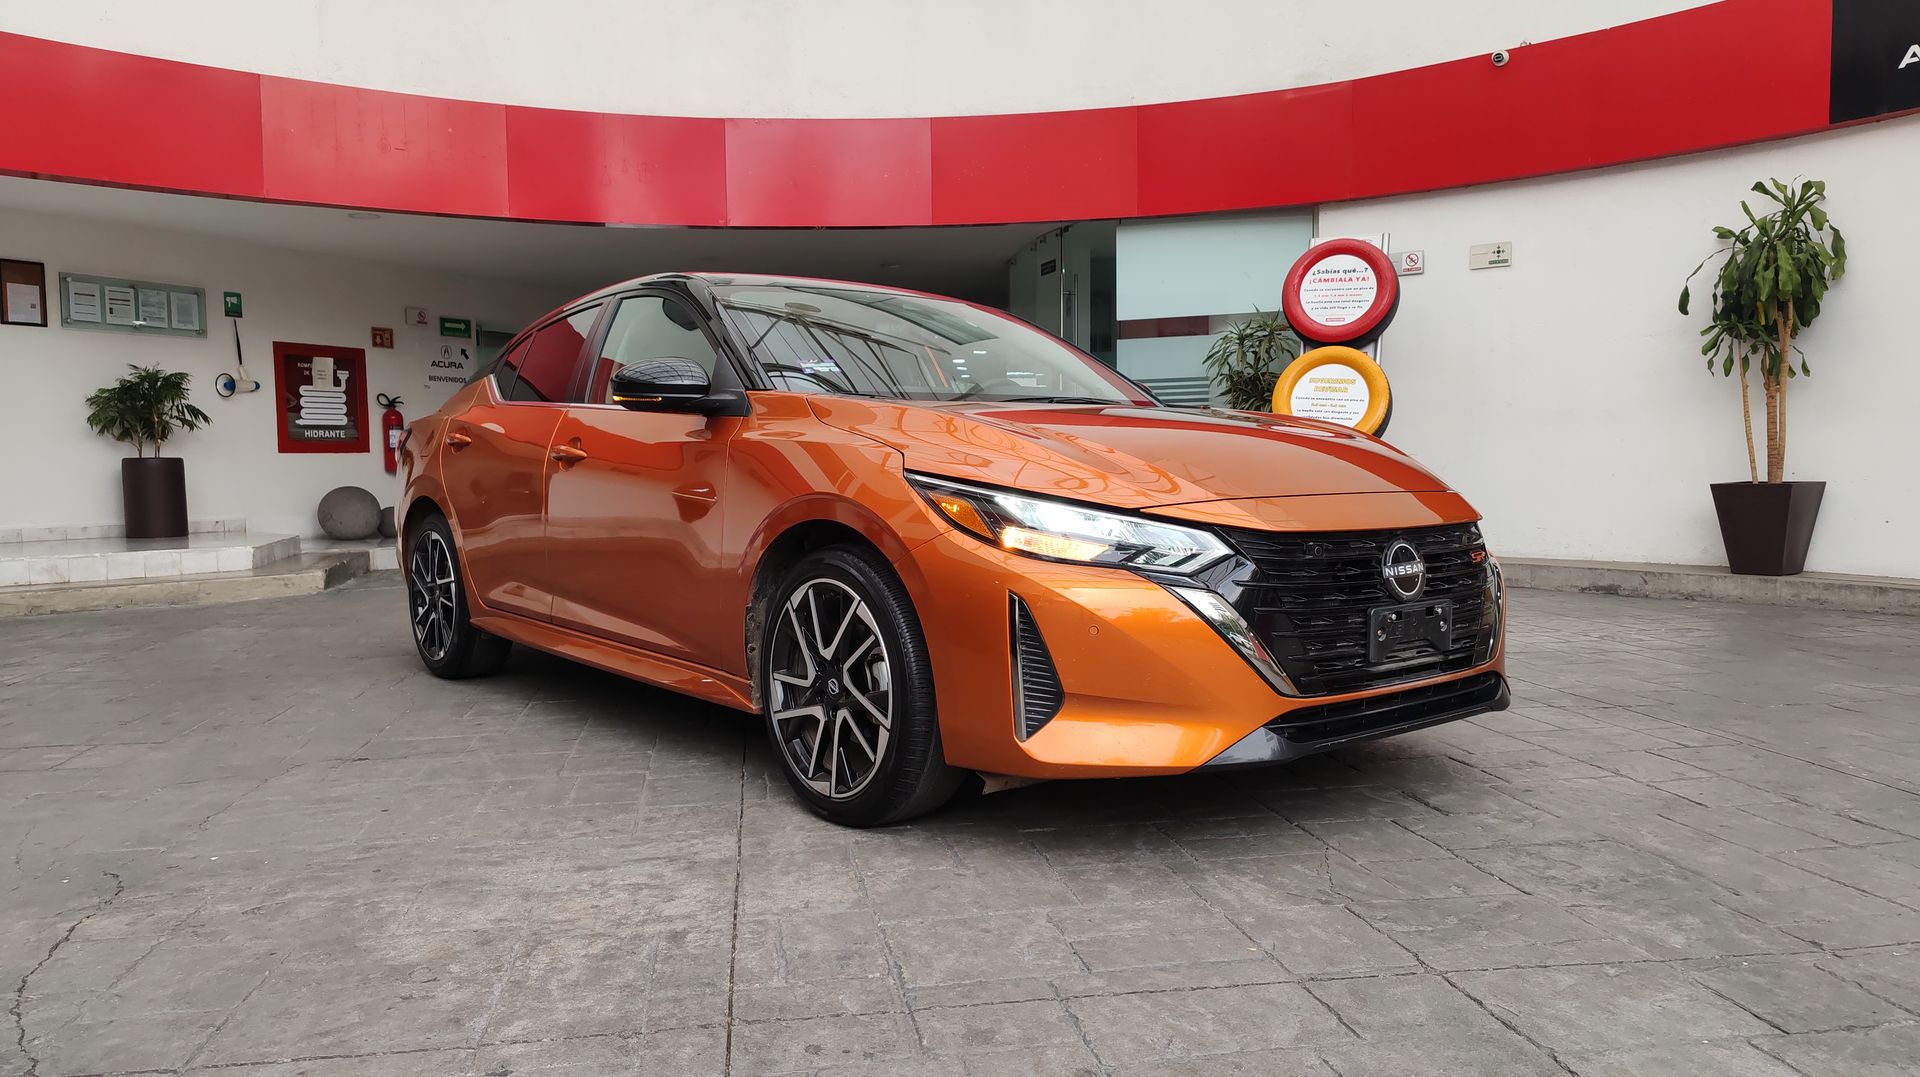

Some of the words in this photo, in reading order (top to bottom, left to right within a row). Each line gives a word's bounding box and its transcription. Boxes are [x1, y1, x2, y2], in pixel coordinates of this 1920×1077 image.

[431, 360, 464, 369] ACURA
[304, 429, 346, 438] HIDRANTE
[1385, 563, 1424, 577] NISSAN
